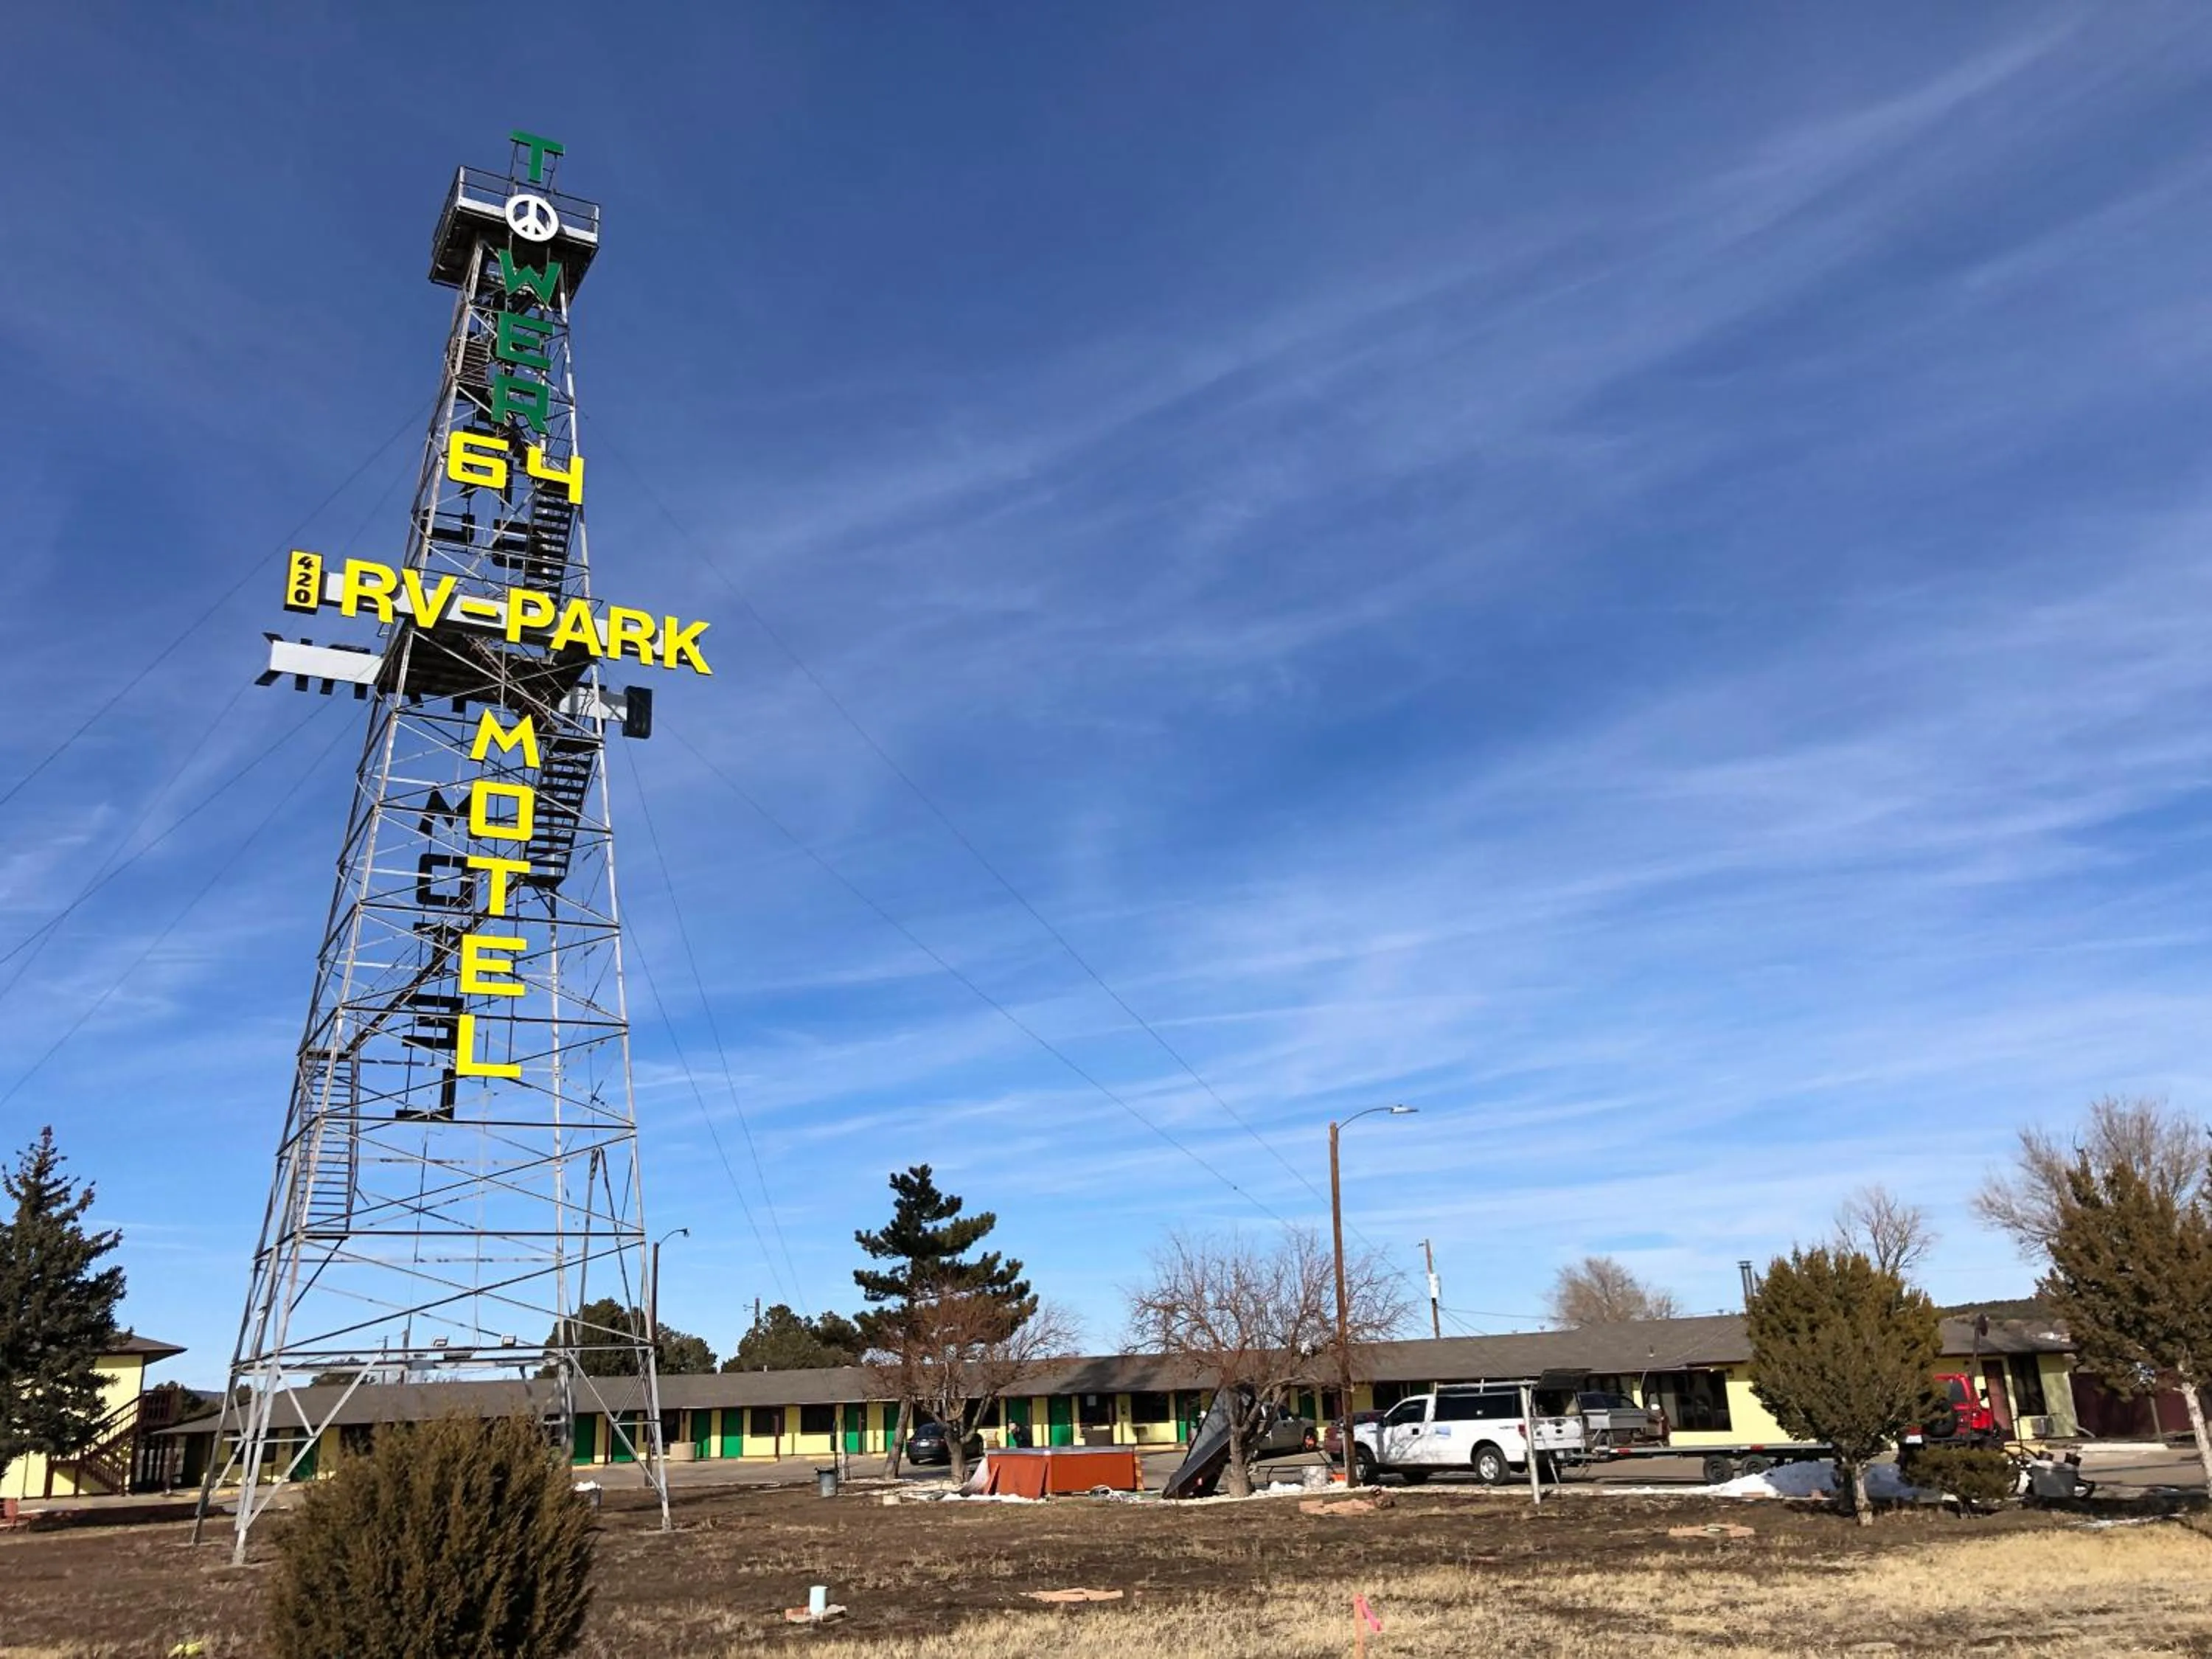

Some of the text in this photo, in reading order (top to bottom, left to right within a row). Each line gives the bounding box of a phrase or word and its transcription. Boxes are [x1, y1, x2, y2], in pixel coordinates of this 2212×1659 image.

[448, 431, 585, 505] 64
[295, 555, 314, 604] 420
[455, 708, 540, 1078] MOTEL
